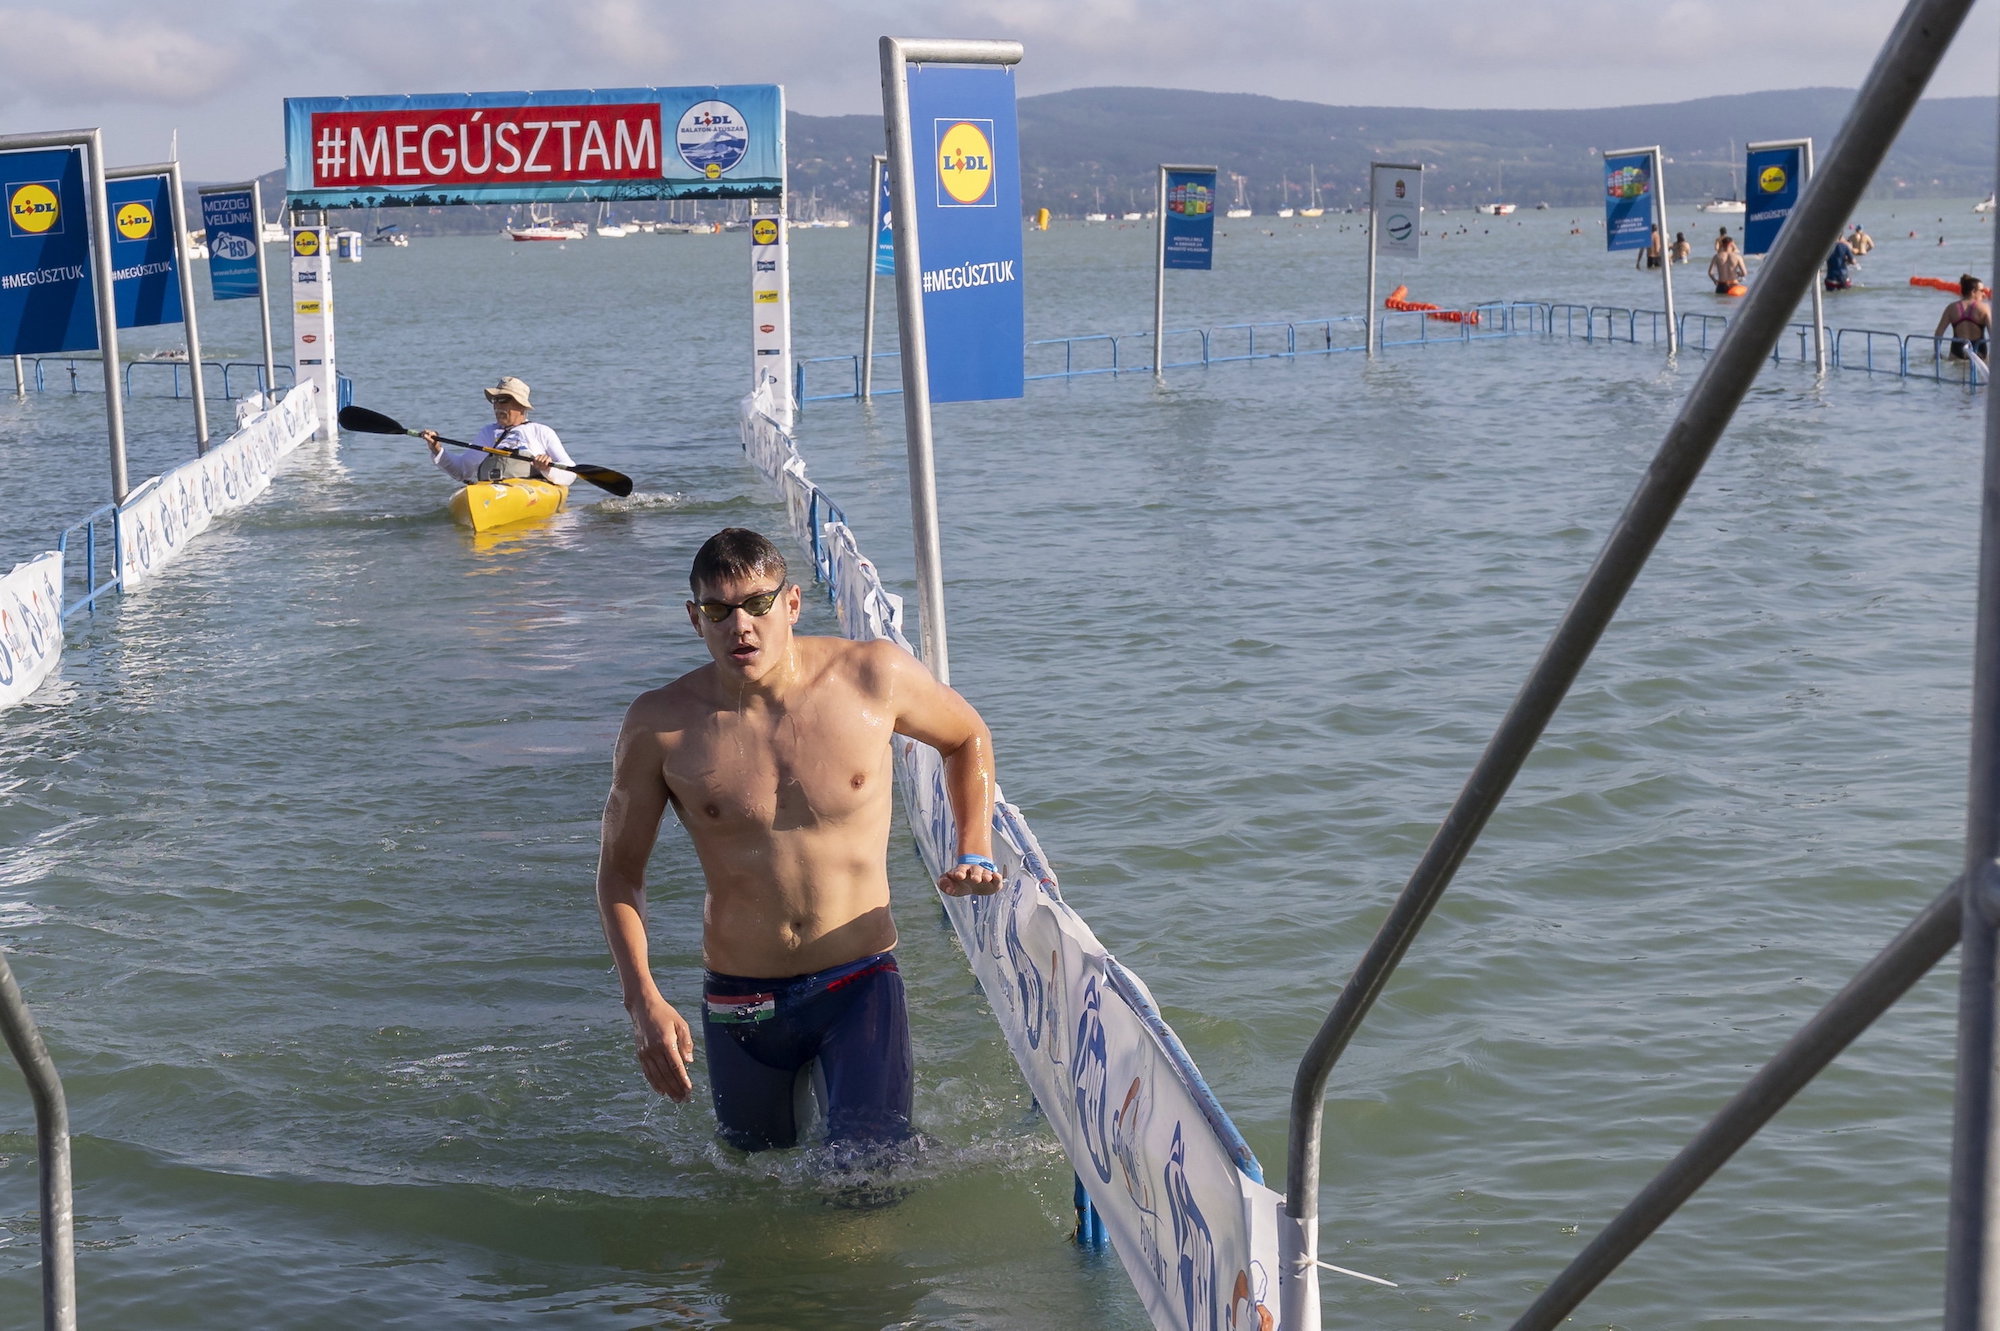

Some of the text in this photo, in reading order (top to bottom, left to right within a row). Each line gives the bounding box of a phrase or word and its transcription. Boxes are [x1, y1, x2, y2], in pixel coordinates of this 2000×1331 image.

[317, 111, 656, 178] #MEGÚSZTAM
[204, 198, 249, 212] MOZOGJ
[1750, 207, 1793, 222] #MEGÚSZTU
[229, 240, 248, 257] BSI
[2, 265, 84, 289] #MEGÚSZTUK
[923, 260, 1014, 292] #MEGÚSZTUK
